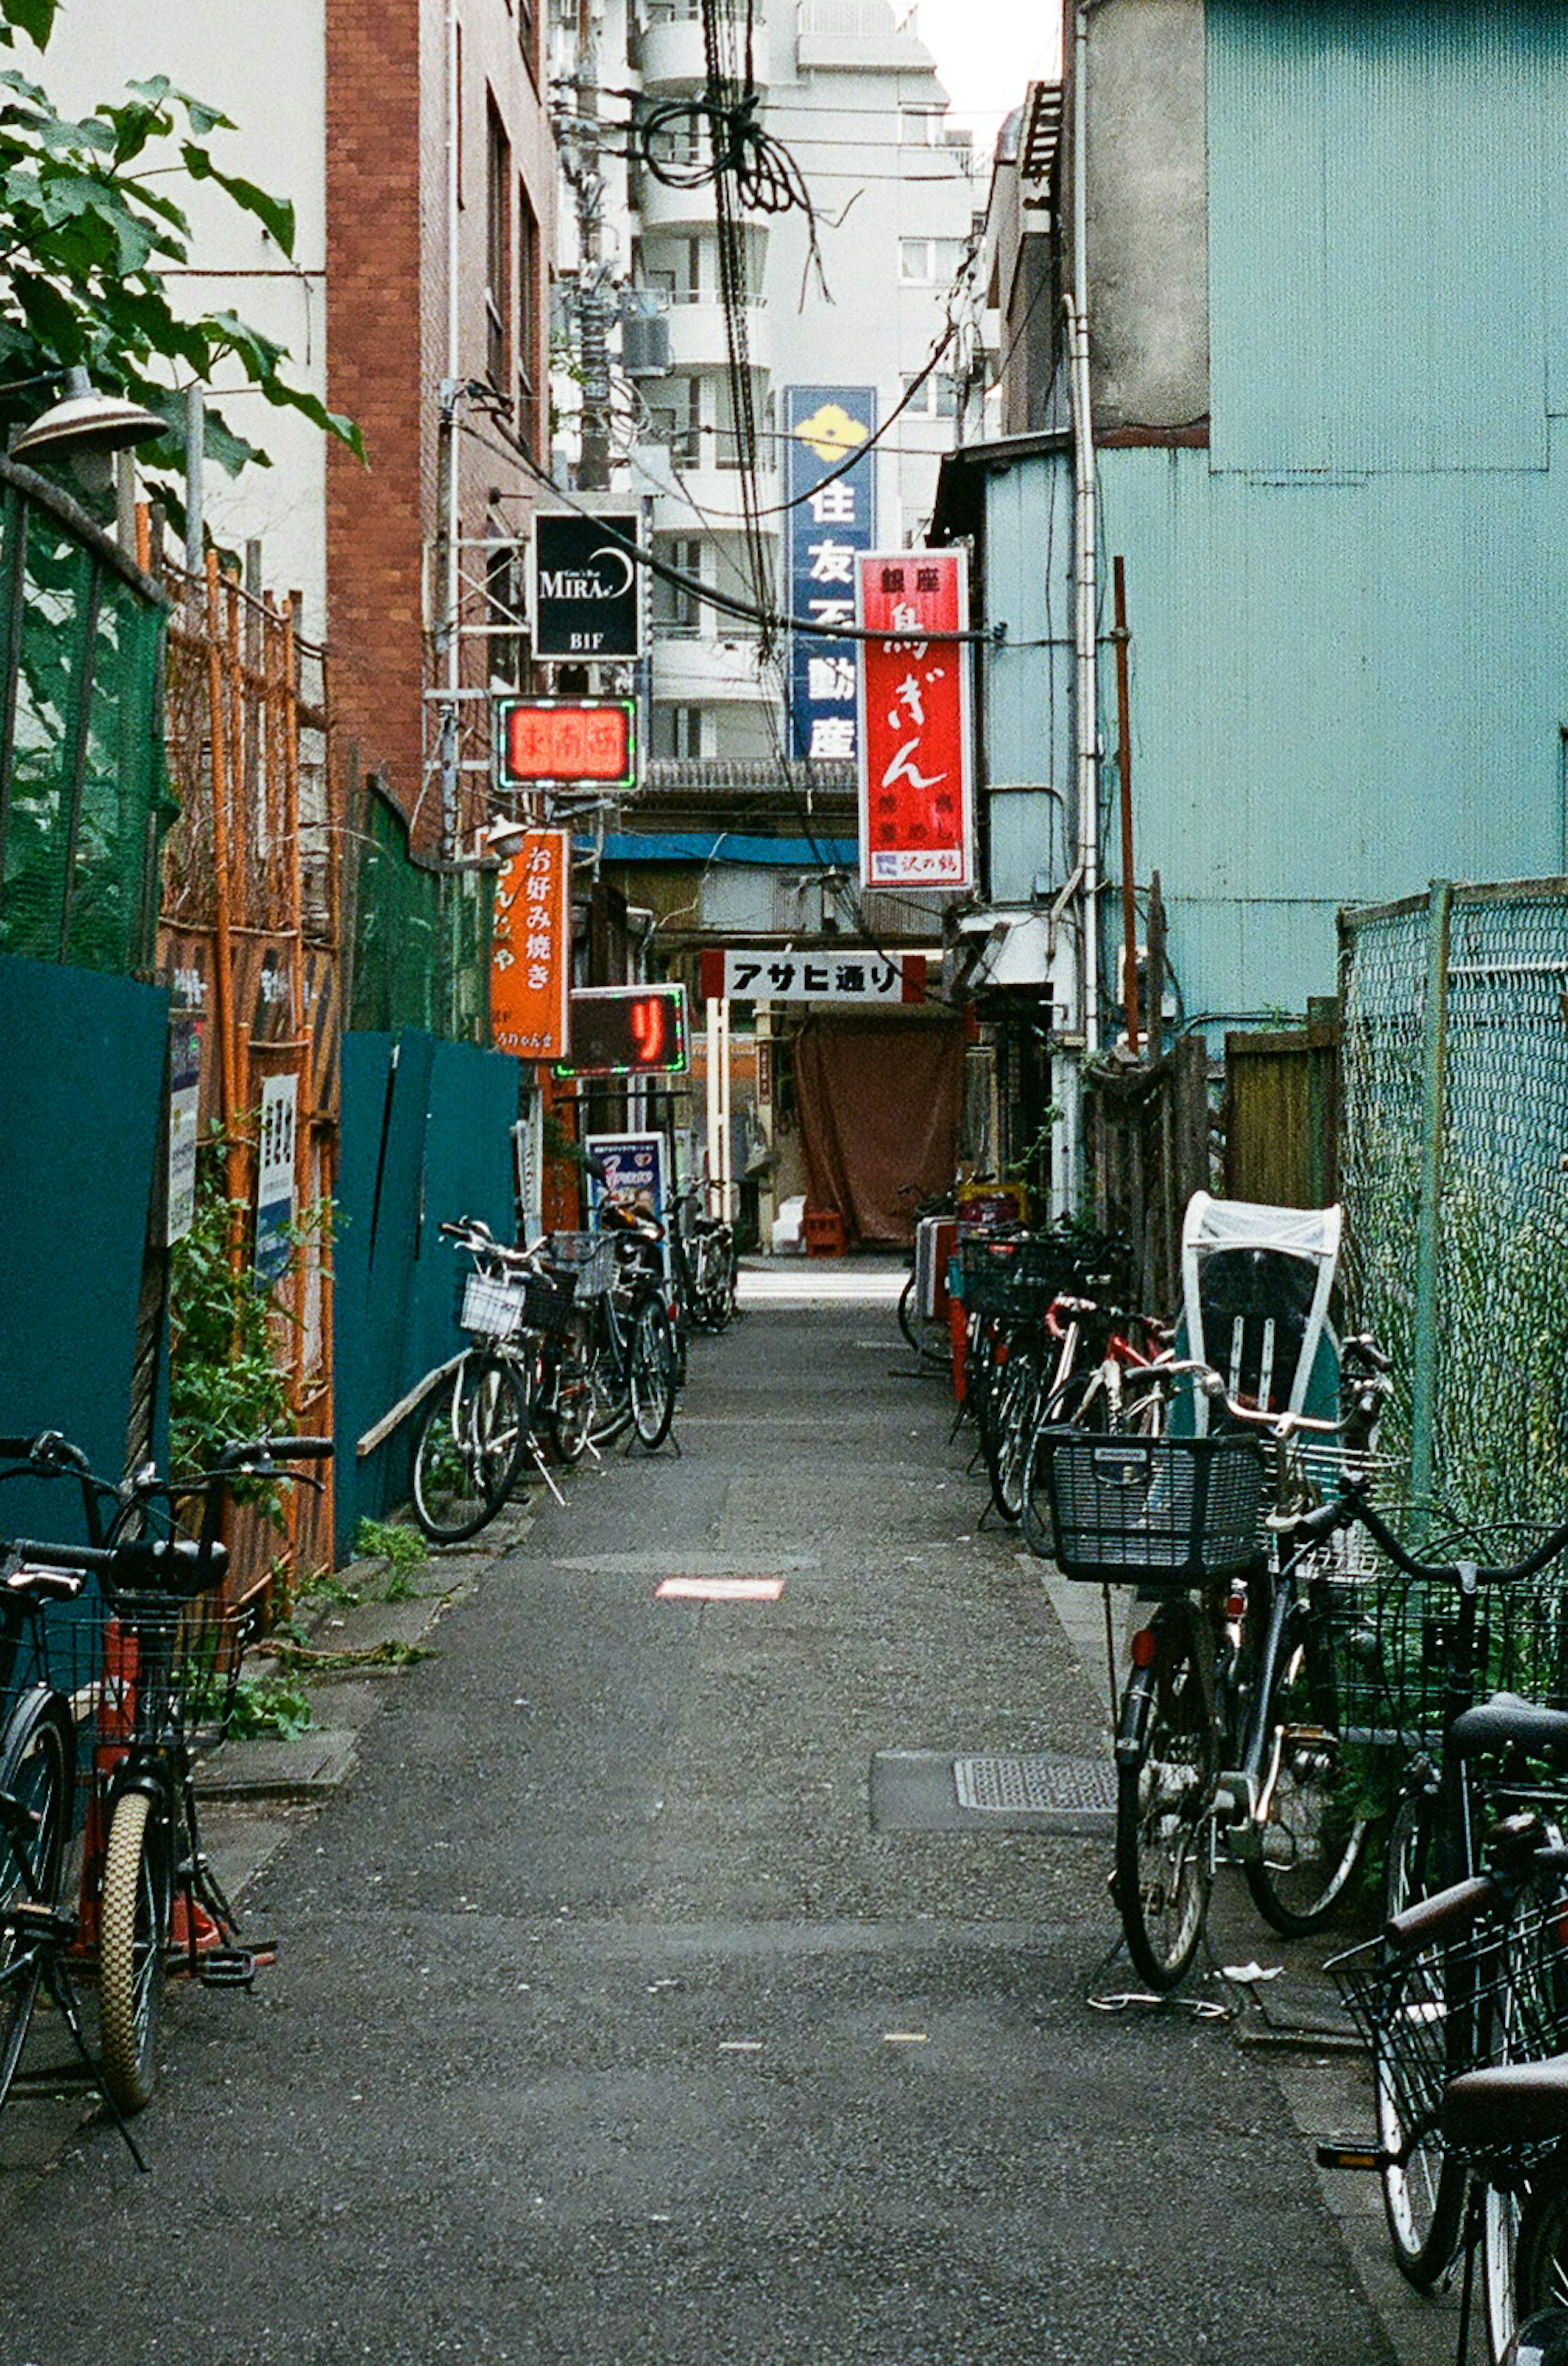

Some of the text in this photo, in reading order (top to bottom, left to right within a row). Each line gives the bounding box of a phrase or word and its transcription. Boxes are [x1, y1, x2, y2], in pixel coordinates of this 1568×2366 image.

[808, 478, 855, 759] 住友不動産
[882, 567, 940, 593] 銀座
[882, 601, 947, 788] 鳥ぎん
[526, 846, 552, 990] お好み焼き
[733, 963, 894, 993] アサヒ通り
